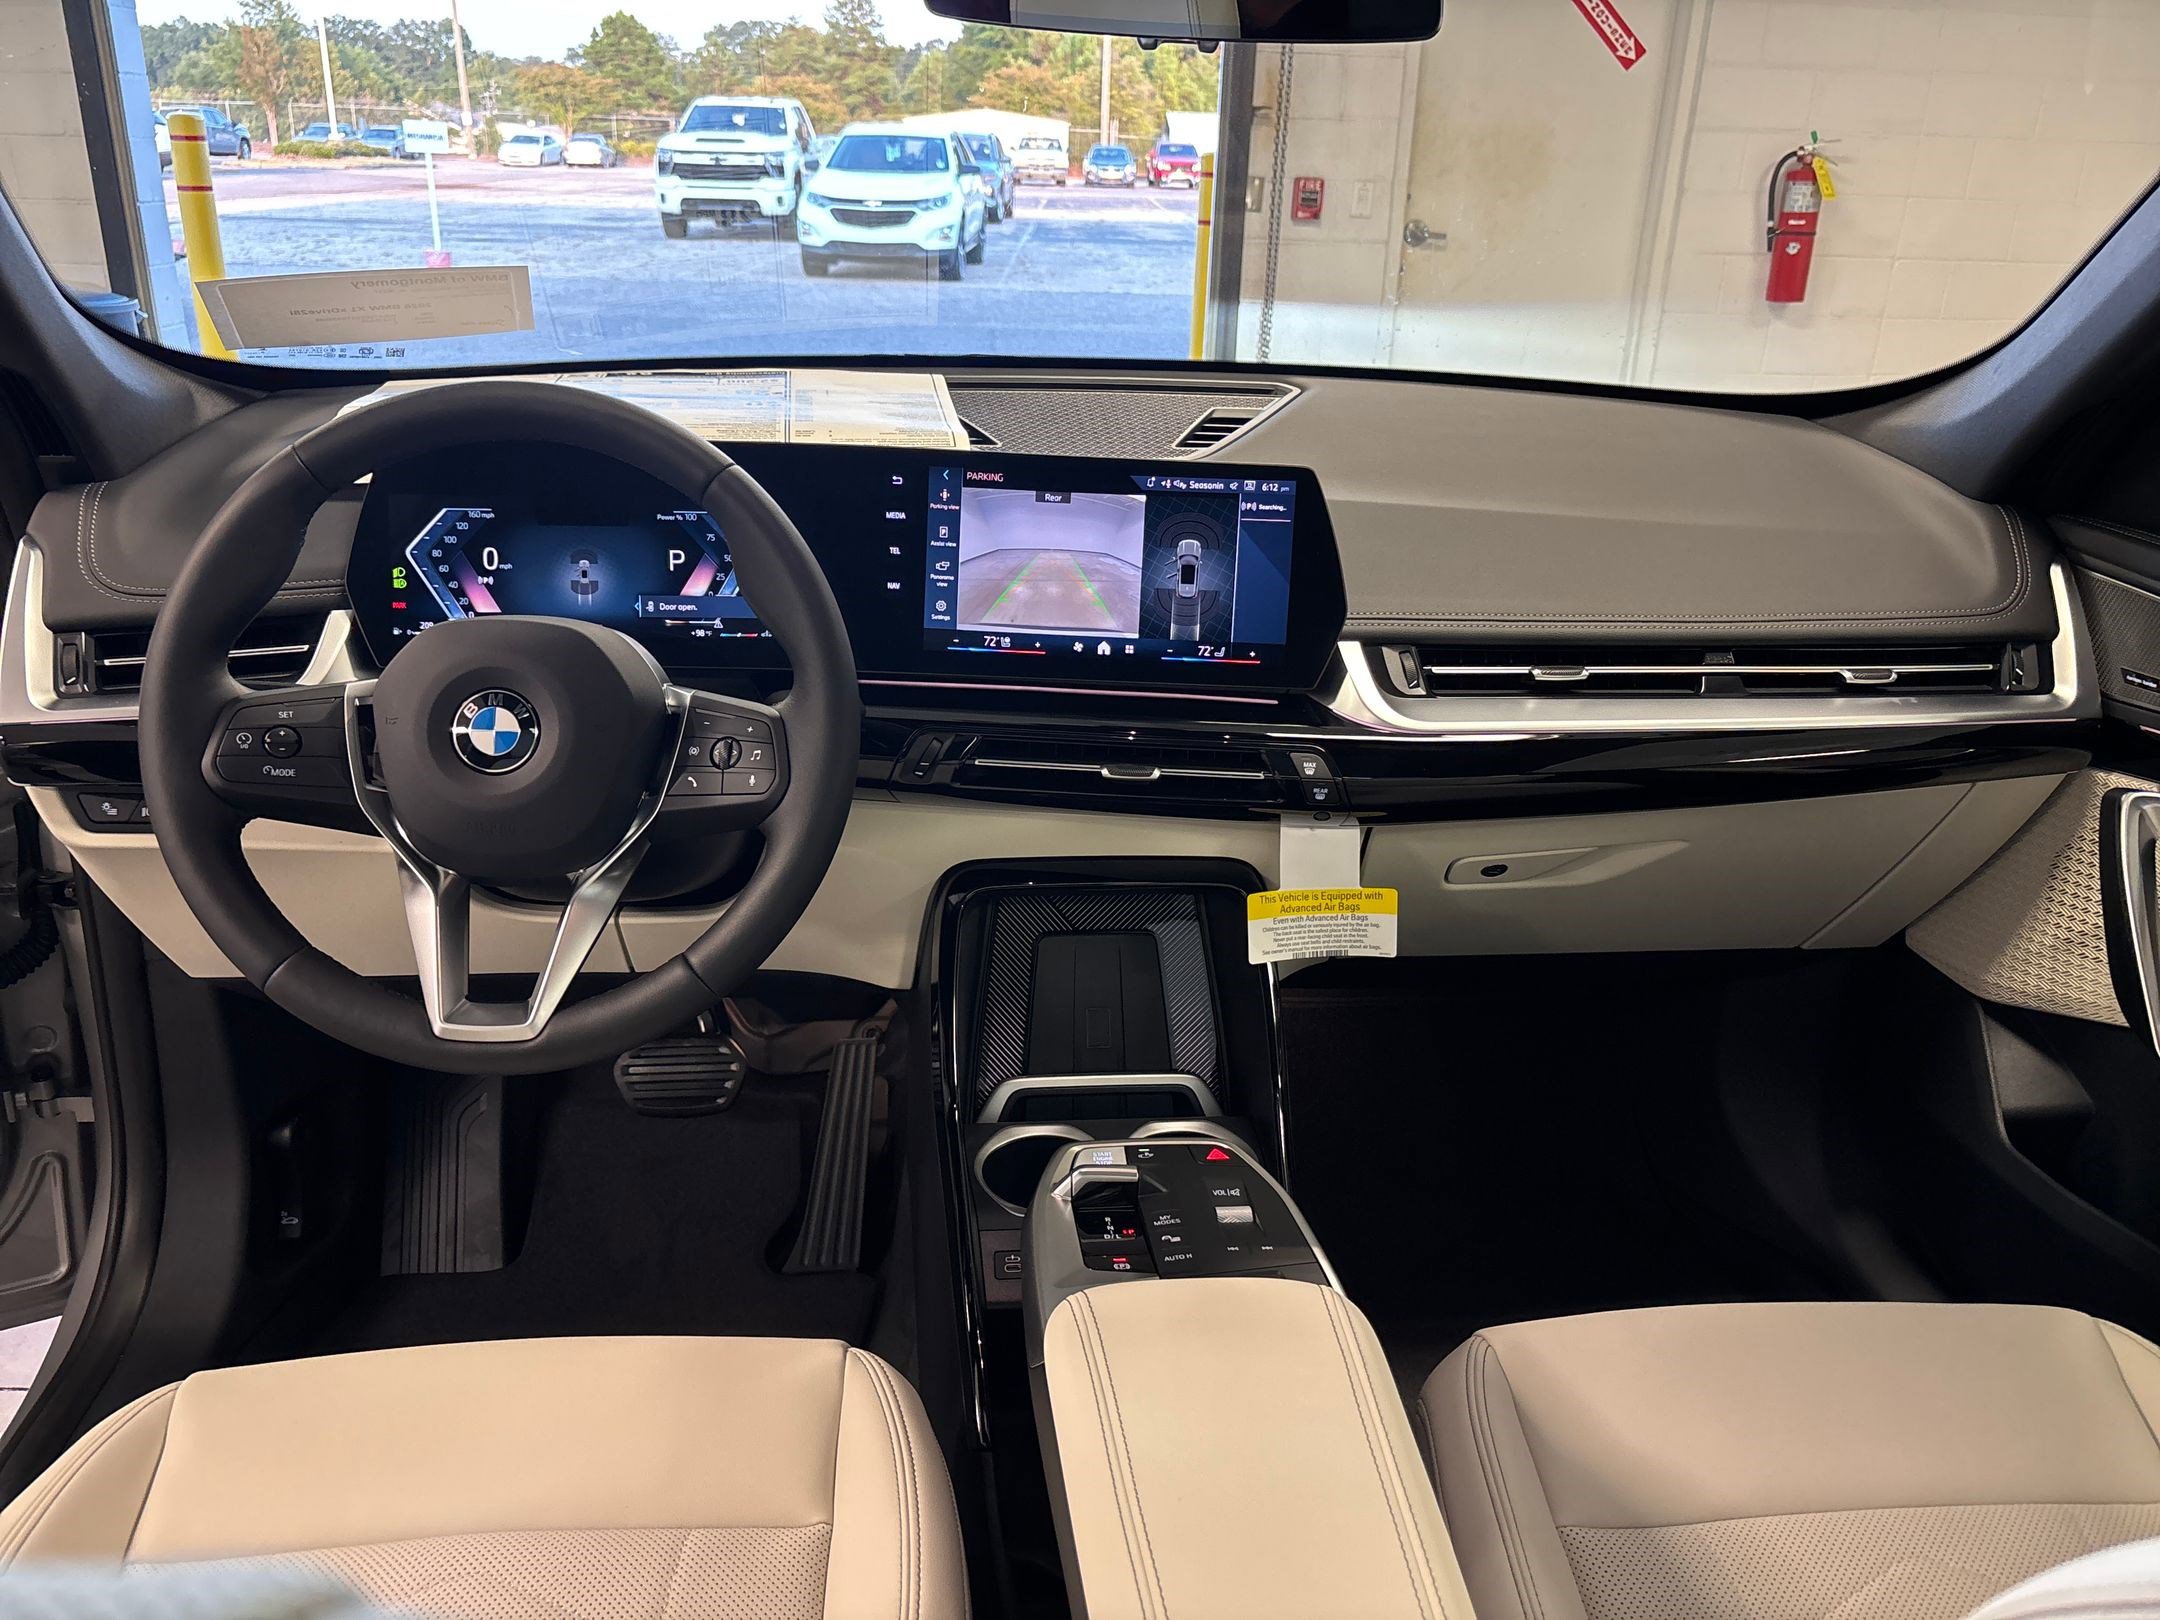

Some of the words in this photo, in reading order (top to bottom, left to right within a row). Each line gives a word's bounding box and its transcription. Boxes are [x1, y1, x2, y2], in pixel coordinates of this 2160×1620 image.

[966, 472, 1004, 482] PARKING
[1189, 480, 1224, 490] Seasonin
[1261, 482, 1278, 491] 6:12
[1044, 493, 1062, 502] Rear
[886, 511, 906, 519] MEDIA
[456, 522, 468, 530] 120
[443, 535, 457, 543] 100
[706, 533, 716, 541] 75
[889, 546, 901, 554] TEL
[482, 547, 499, 570] 0
[669, 549, 685, 571] P
[439, 565, 449, 573] 60
[716, 573, 725, 581] 25
[930, 573, 955, 581] Panorama
[448, 581, 458, 589] 40
[460, 597, 469, 606] 20
[659, 602, 677, 611] Door
[678, 603, 698, 612] open.
[931, 613, 951, 621] Settings
[463, 693, 530, 720] BMW
[278, 711, 294, 719] SET
[271, 768, 297, 777] MODE
[1259, 895, 1276, 904] This
[1277, 892, 1310, 902] Vehicle
[1312, 892, 1319, 900] is
[1321, 891, 1362, 902] Equipped
[1365, 891, 1383, 900] with
[1280, 903, 1322, 914] Advanced
[1324, 902, 1337, 911] Air
[1338, 902, 1360, 912] Bags
[1273, 917, 1288, 925] Even
[1289, 915, 1304, 923] with
[1351, 913, 1369, 922] Bags
[1212, 1188, 1226, 1196] VOL
[1153, 1218, 1181, 1226] MODES
[1164, 1253, 1185, 1261] AUTO
